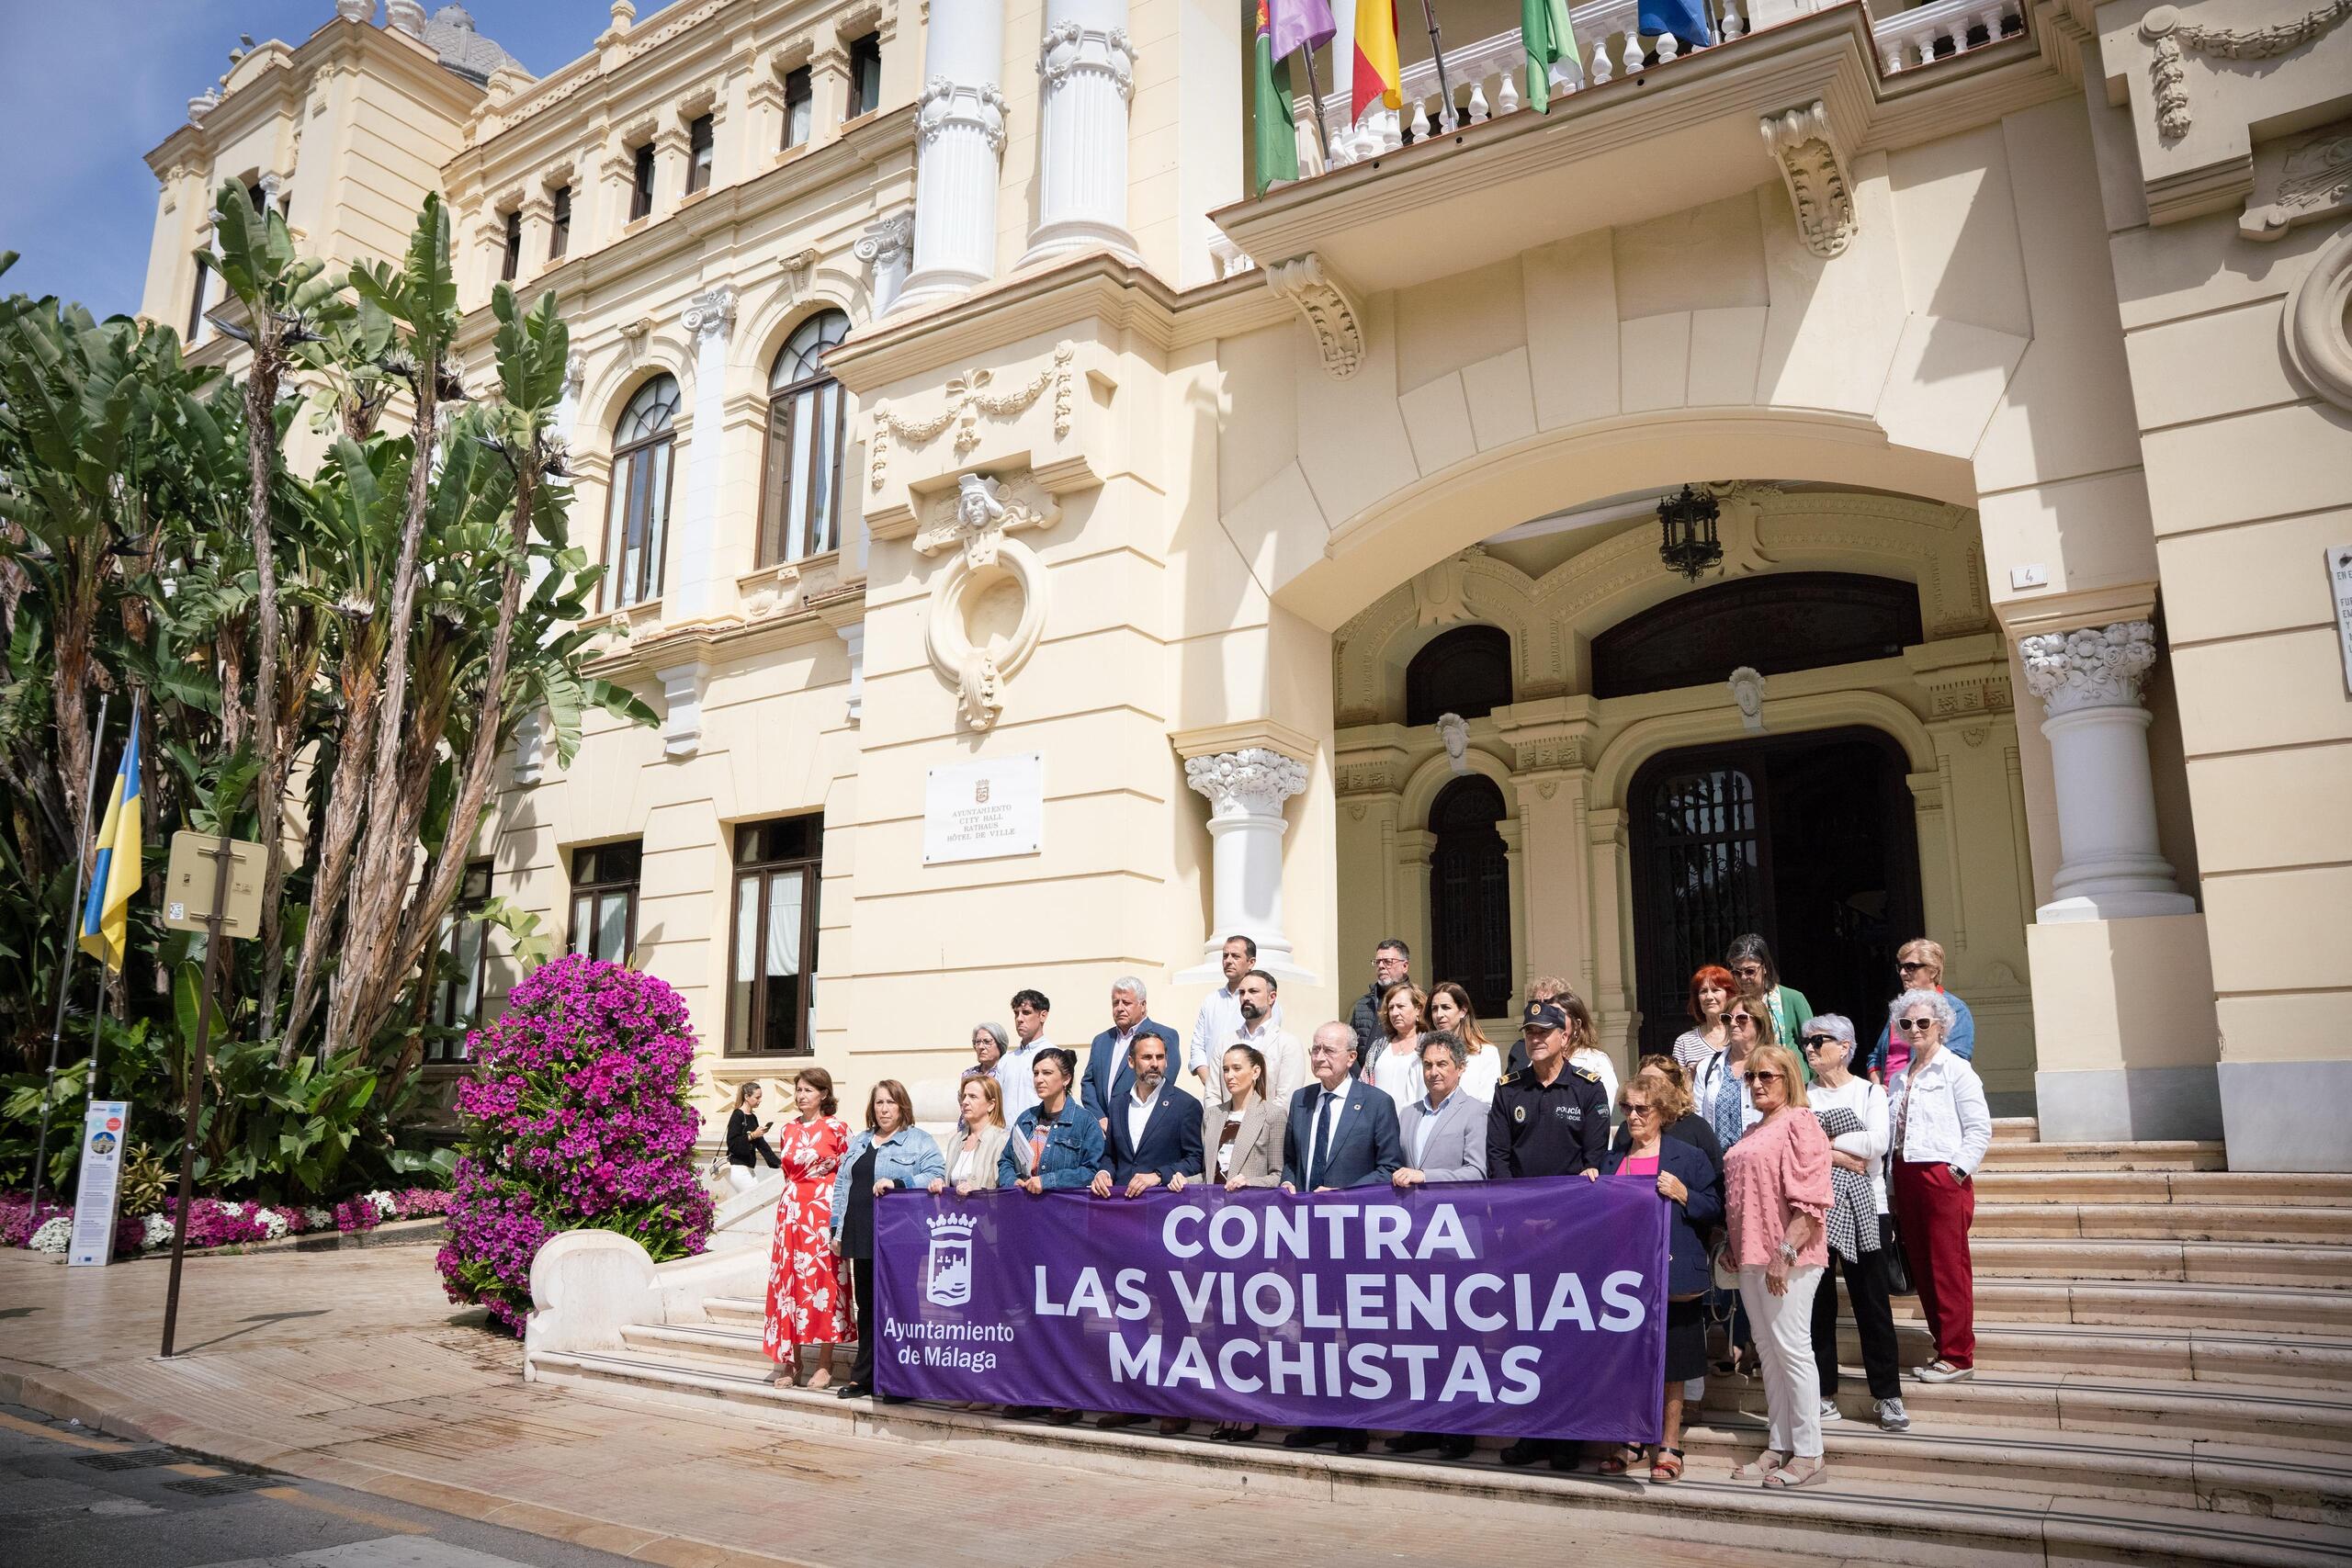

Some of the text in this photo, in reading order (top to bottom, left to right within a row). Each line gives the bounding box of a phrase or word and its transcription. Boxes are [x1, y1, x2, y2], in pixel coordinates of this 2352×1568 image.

[2026, 569, 2034, 581] 4
[952, 805, 1012, 818] AYUNTAMIENTO
[959, 813, 1003, 825] CITY HALL
[964, 822, 999, 832] RATHAUS
[947, 833, 971, 842] HÔTEL
[989, 828, 1015, 837] VILLE
[1555, 1106, 1580, 1115] POLICÍA
[1162, 1204, 1476, 1259] CONTRA
[1035, 1265, 1645, 1333] LAS VIOLENCIAS
[883, 1317, 1014, 1342] Ayuntamiento
[898, 1345, 997, 1373] de Málaga
[1109, 1331, 1543, 1405] MACHISTAS
